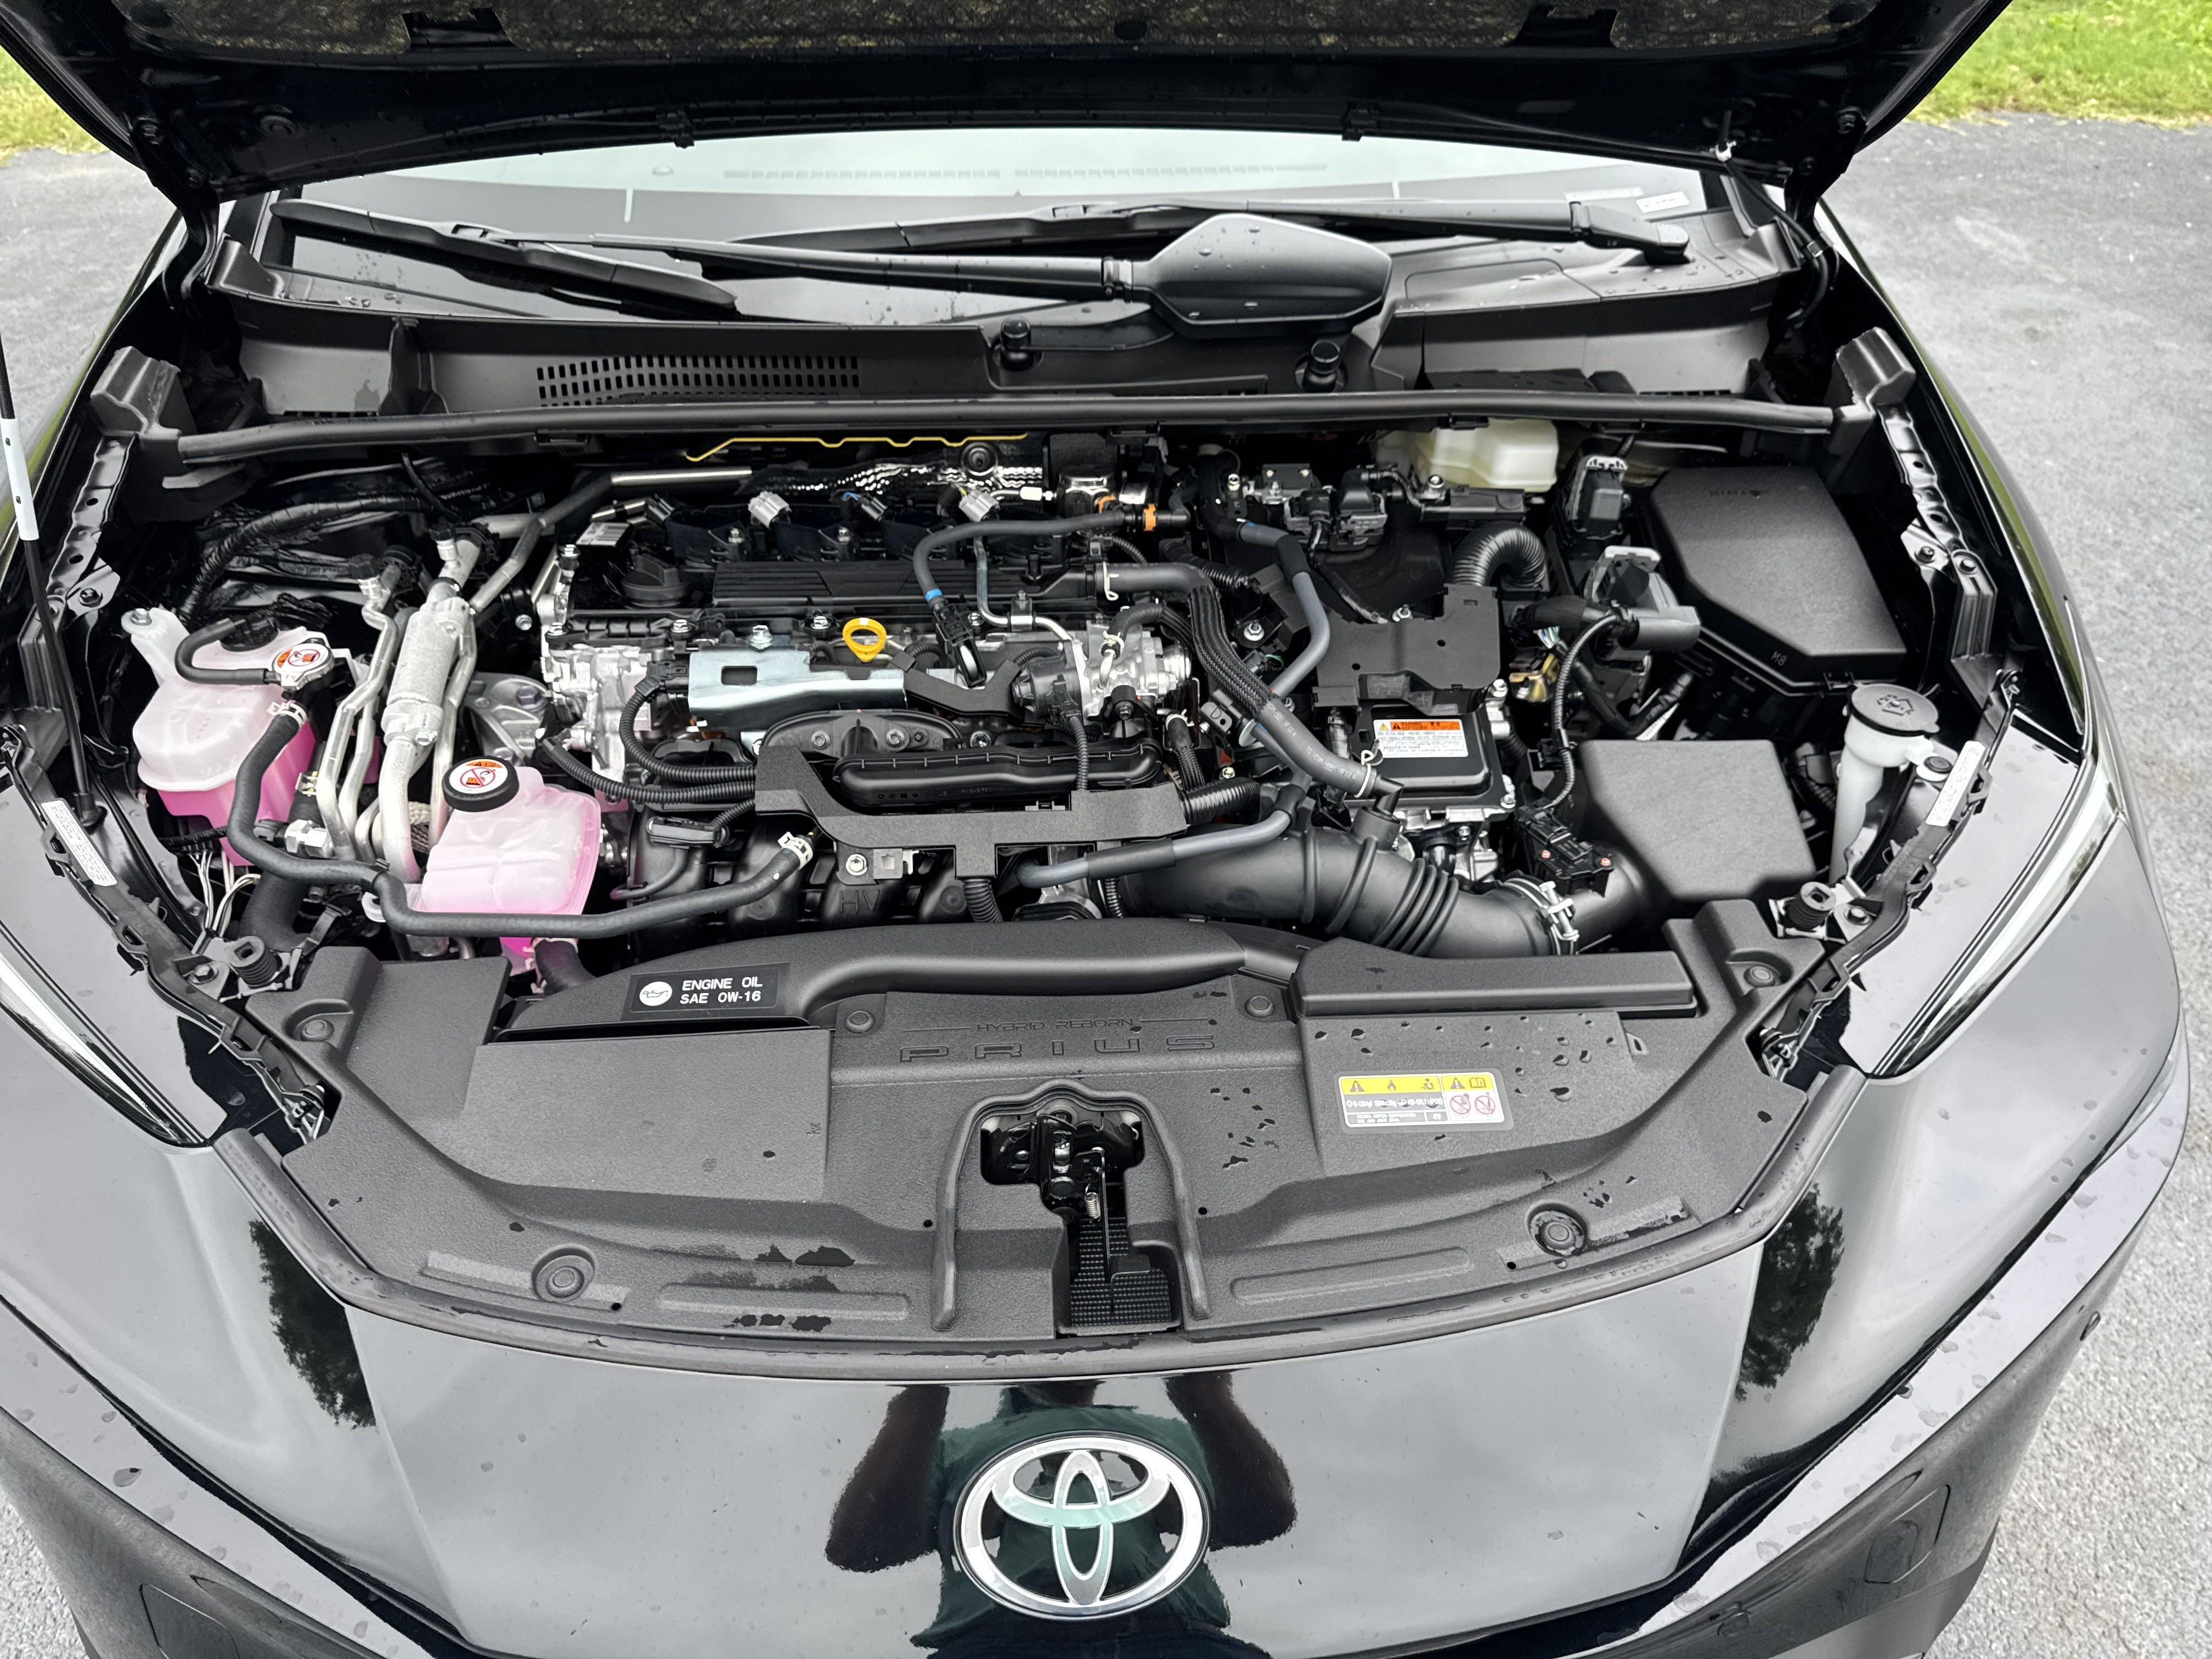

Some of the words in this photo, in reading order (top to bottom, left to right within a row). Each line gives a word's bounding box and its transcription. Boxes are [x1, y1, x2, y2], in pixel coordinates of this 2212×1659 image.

[839, 889, 881, 913] HV
[682, 978, 733, 991] ENGINE
[741, 976, 763, 988] OIL
[680, 992, 709, 1005] SAE
[718, 990, 761, 1003] 0W-16
[977, 1021, 1045, 1032] HYBRID
[1056, 1018, 1133, 1029] REBORN
[899, 1035, 1215, 1063] PRIUS
